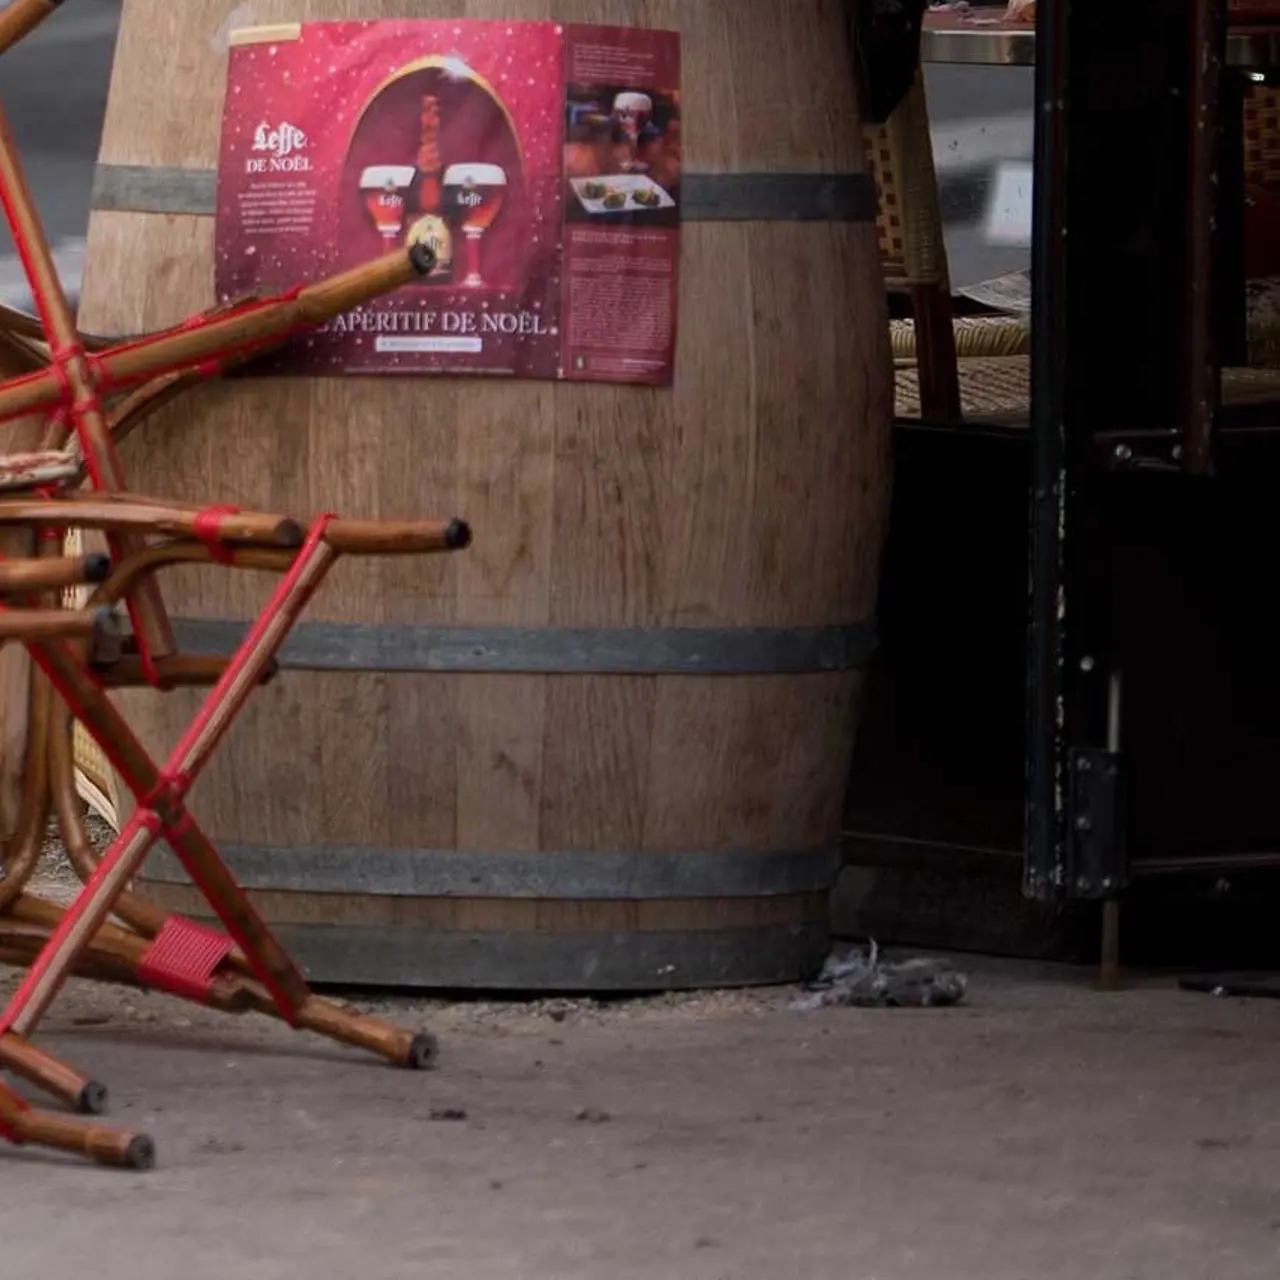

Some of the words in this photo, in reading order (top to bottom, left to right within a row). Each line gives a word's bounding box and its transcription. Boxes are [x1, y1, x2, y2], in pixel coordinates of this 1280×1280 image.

[251, 120, 308, 156] Leffe
[246, 158, 268, 173] DE
[269, 155, 314, 173] NOËL
[443, 311, 477, 333] DE
[482, 310, 548, 335] NOËL
